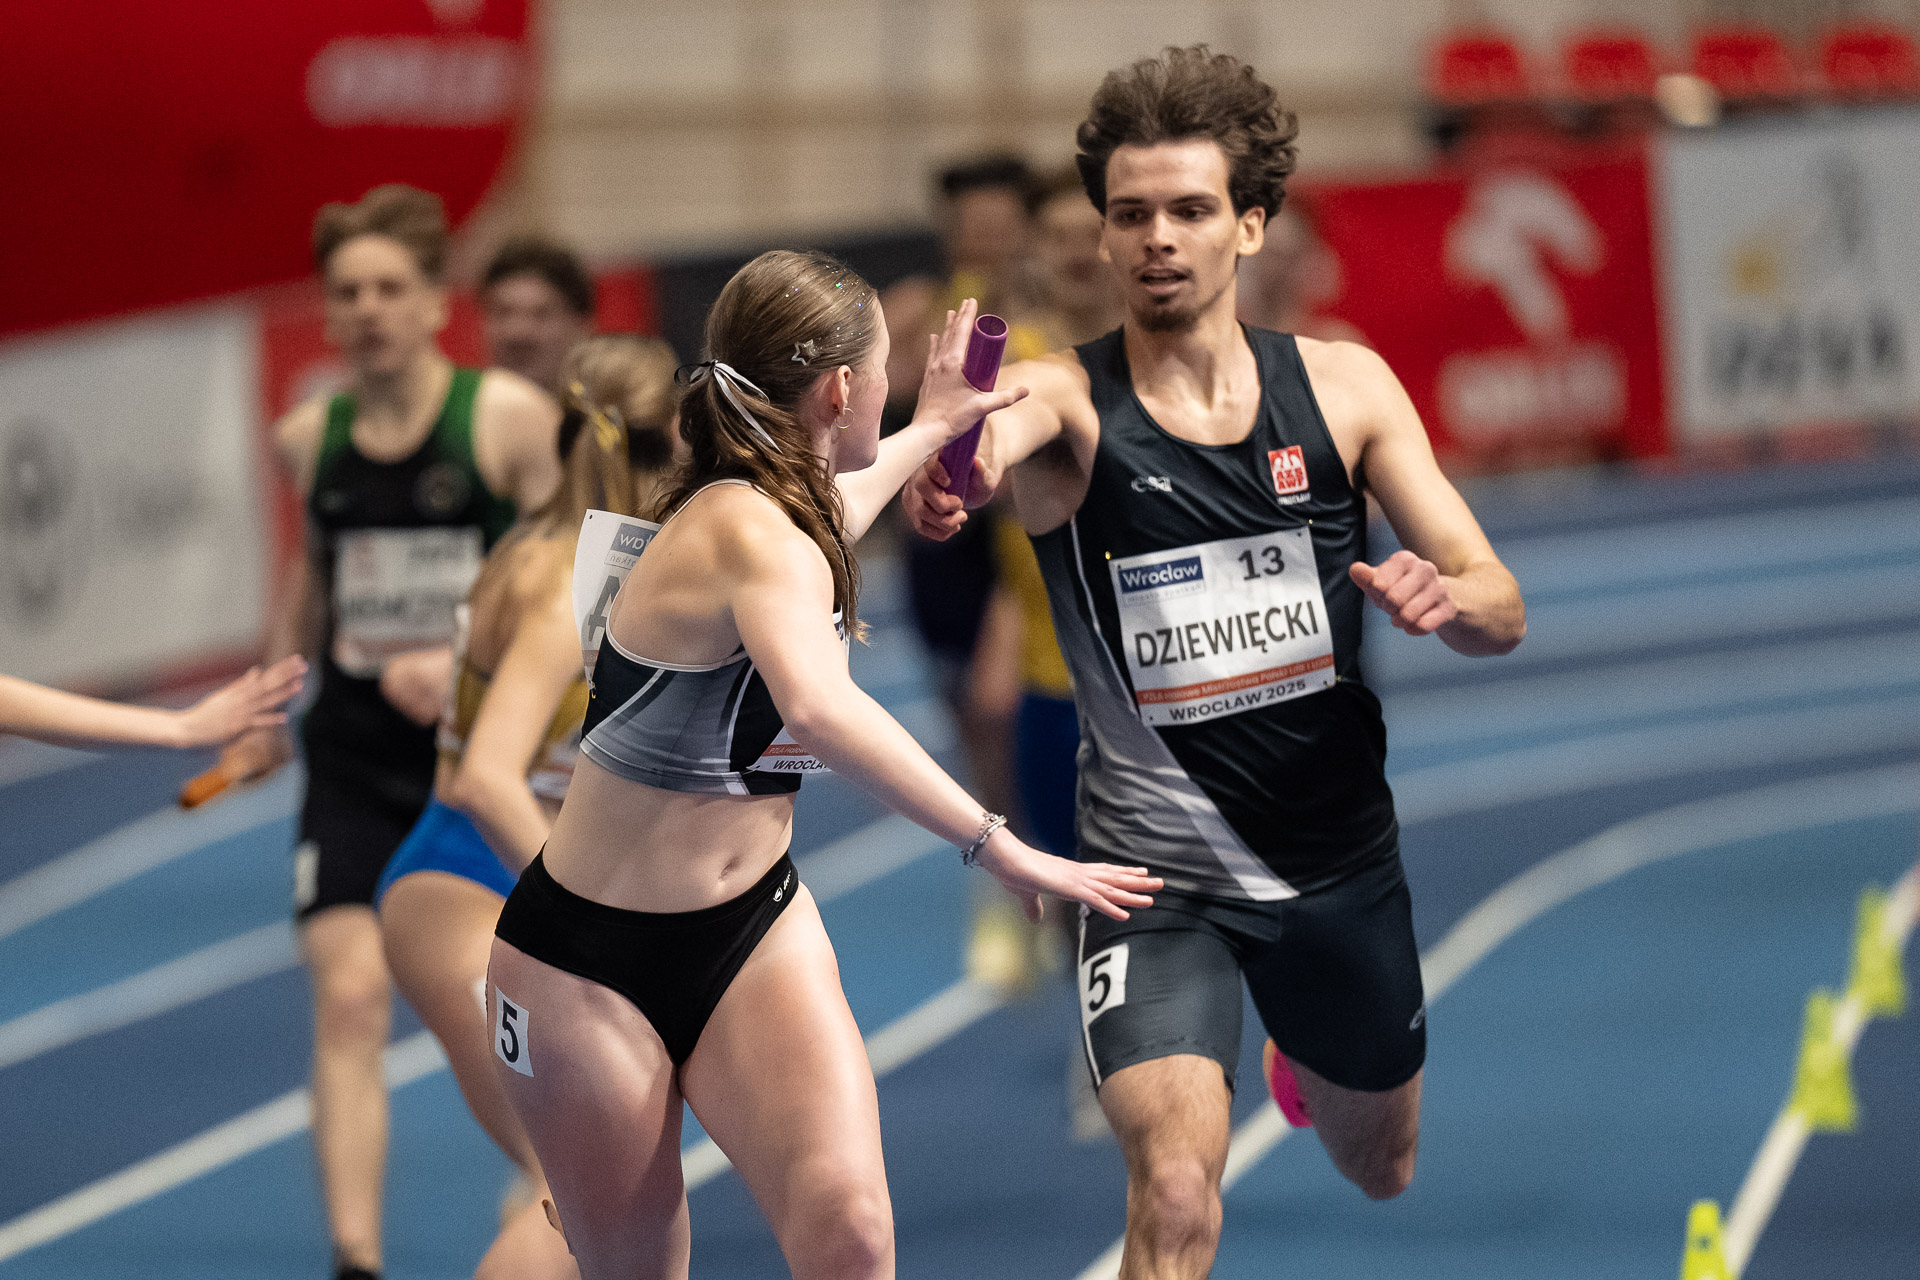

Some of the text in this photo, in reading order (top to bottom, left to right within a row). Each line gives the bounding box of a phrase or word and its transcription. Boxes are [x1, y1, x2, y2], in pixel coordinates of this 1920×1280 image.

[1238, 545, 1285, 581] 13
[1134, 600, 1319, 668] DZIEWIĘCKI
[1169, 680, 1306, 721] WROCŁAW 2025
[772, 759, 827, 770] WROCŁA
[1088, 953, 1111, 1011] 5
[501, 999, 519, 1063] 5
